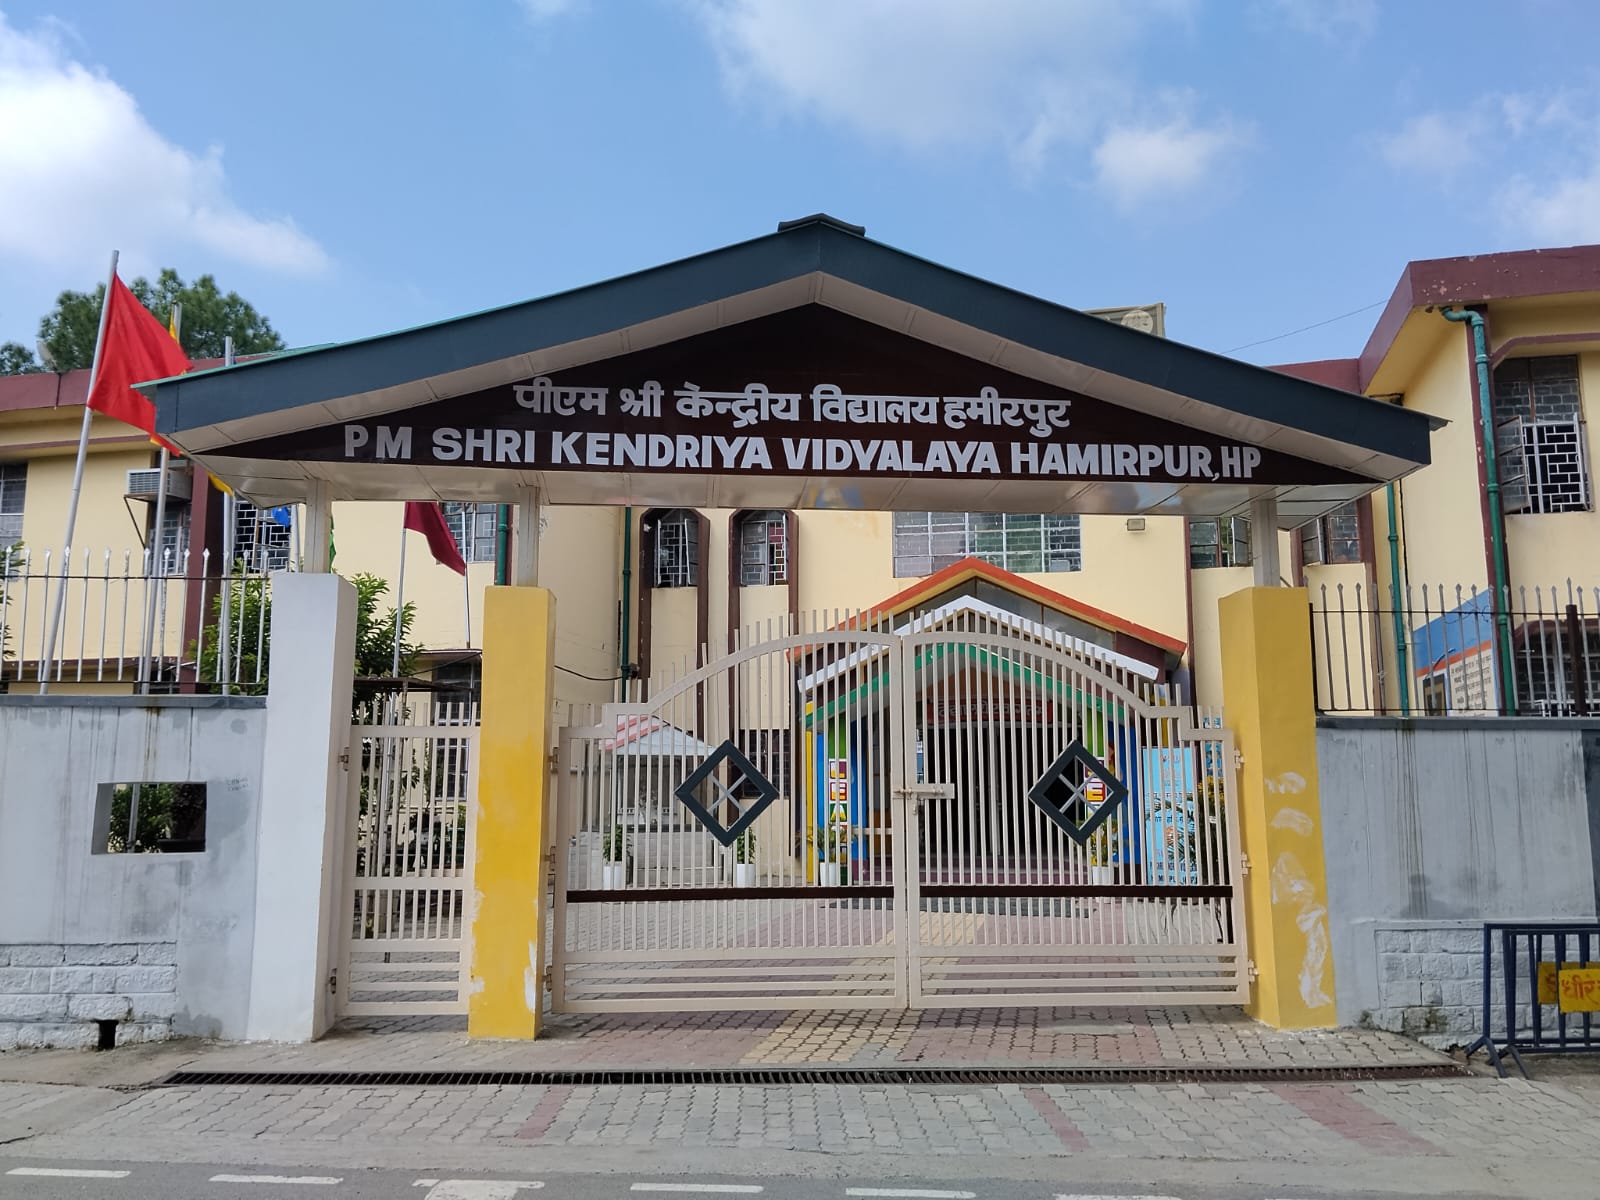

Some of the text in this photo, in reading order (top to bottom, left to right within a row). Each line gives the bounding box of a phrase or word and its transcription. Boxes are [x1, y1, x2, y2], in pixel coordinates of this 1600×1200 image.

[513, 376, 1071, 437] पीएम श्री केन्द्रीय विद्यालय हमीरपुर
[432, 427, 536, 462] SHRI
[551, 431, 773, 469] KENDRIYA
[781, 437, 1001, 473] VIDYALAYA
